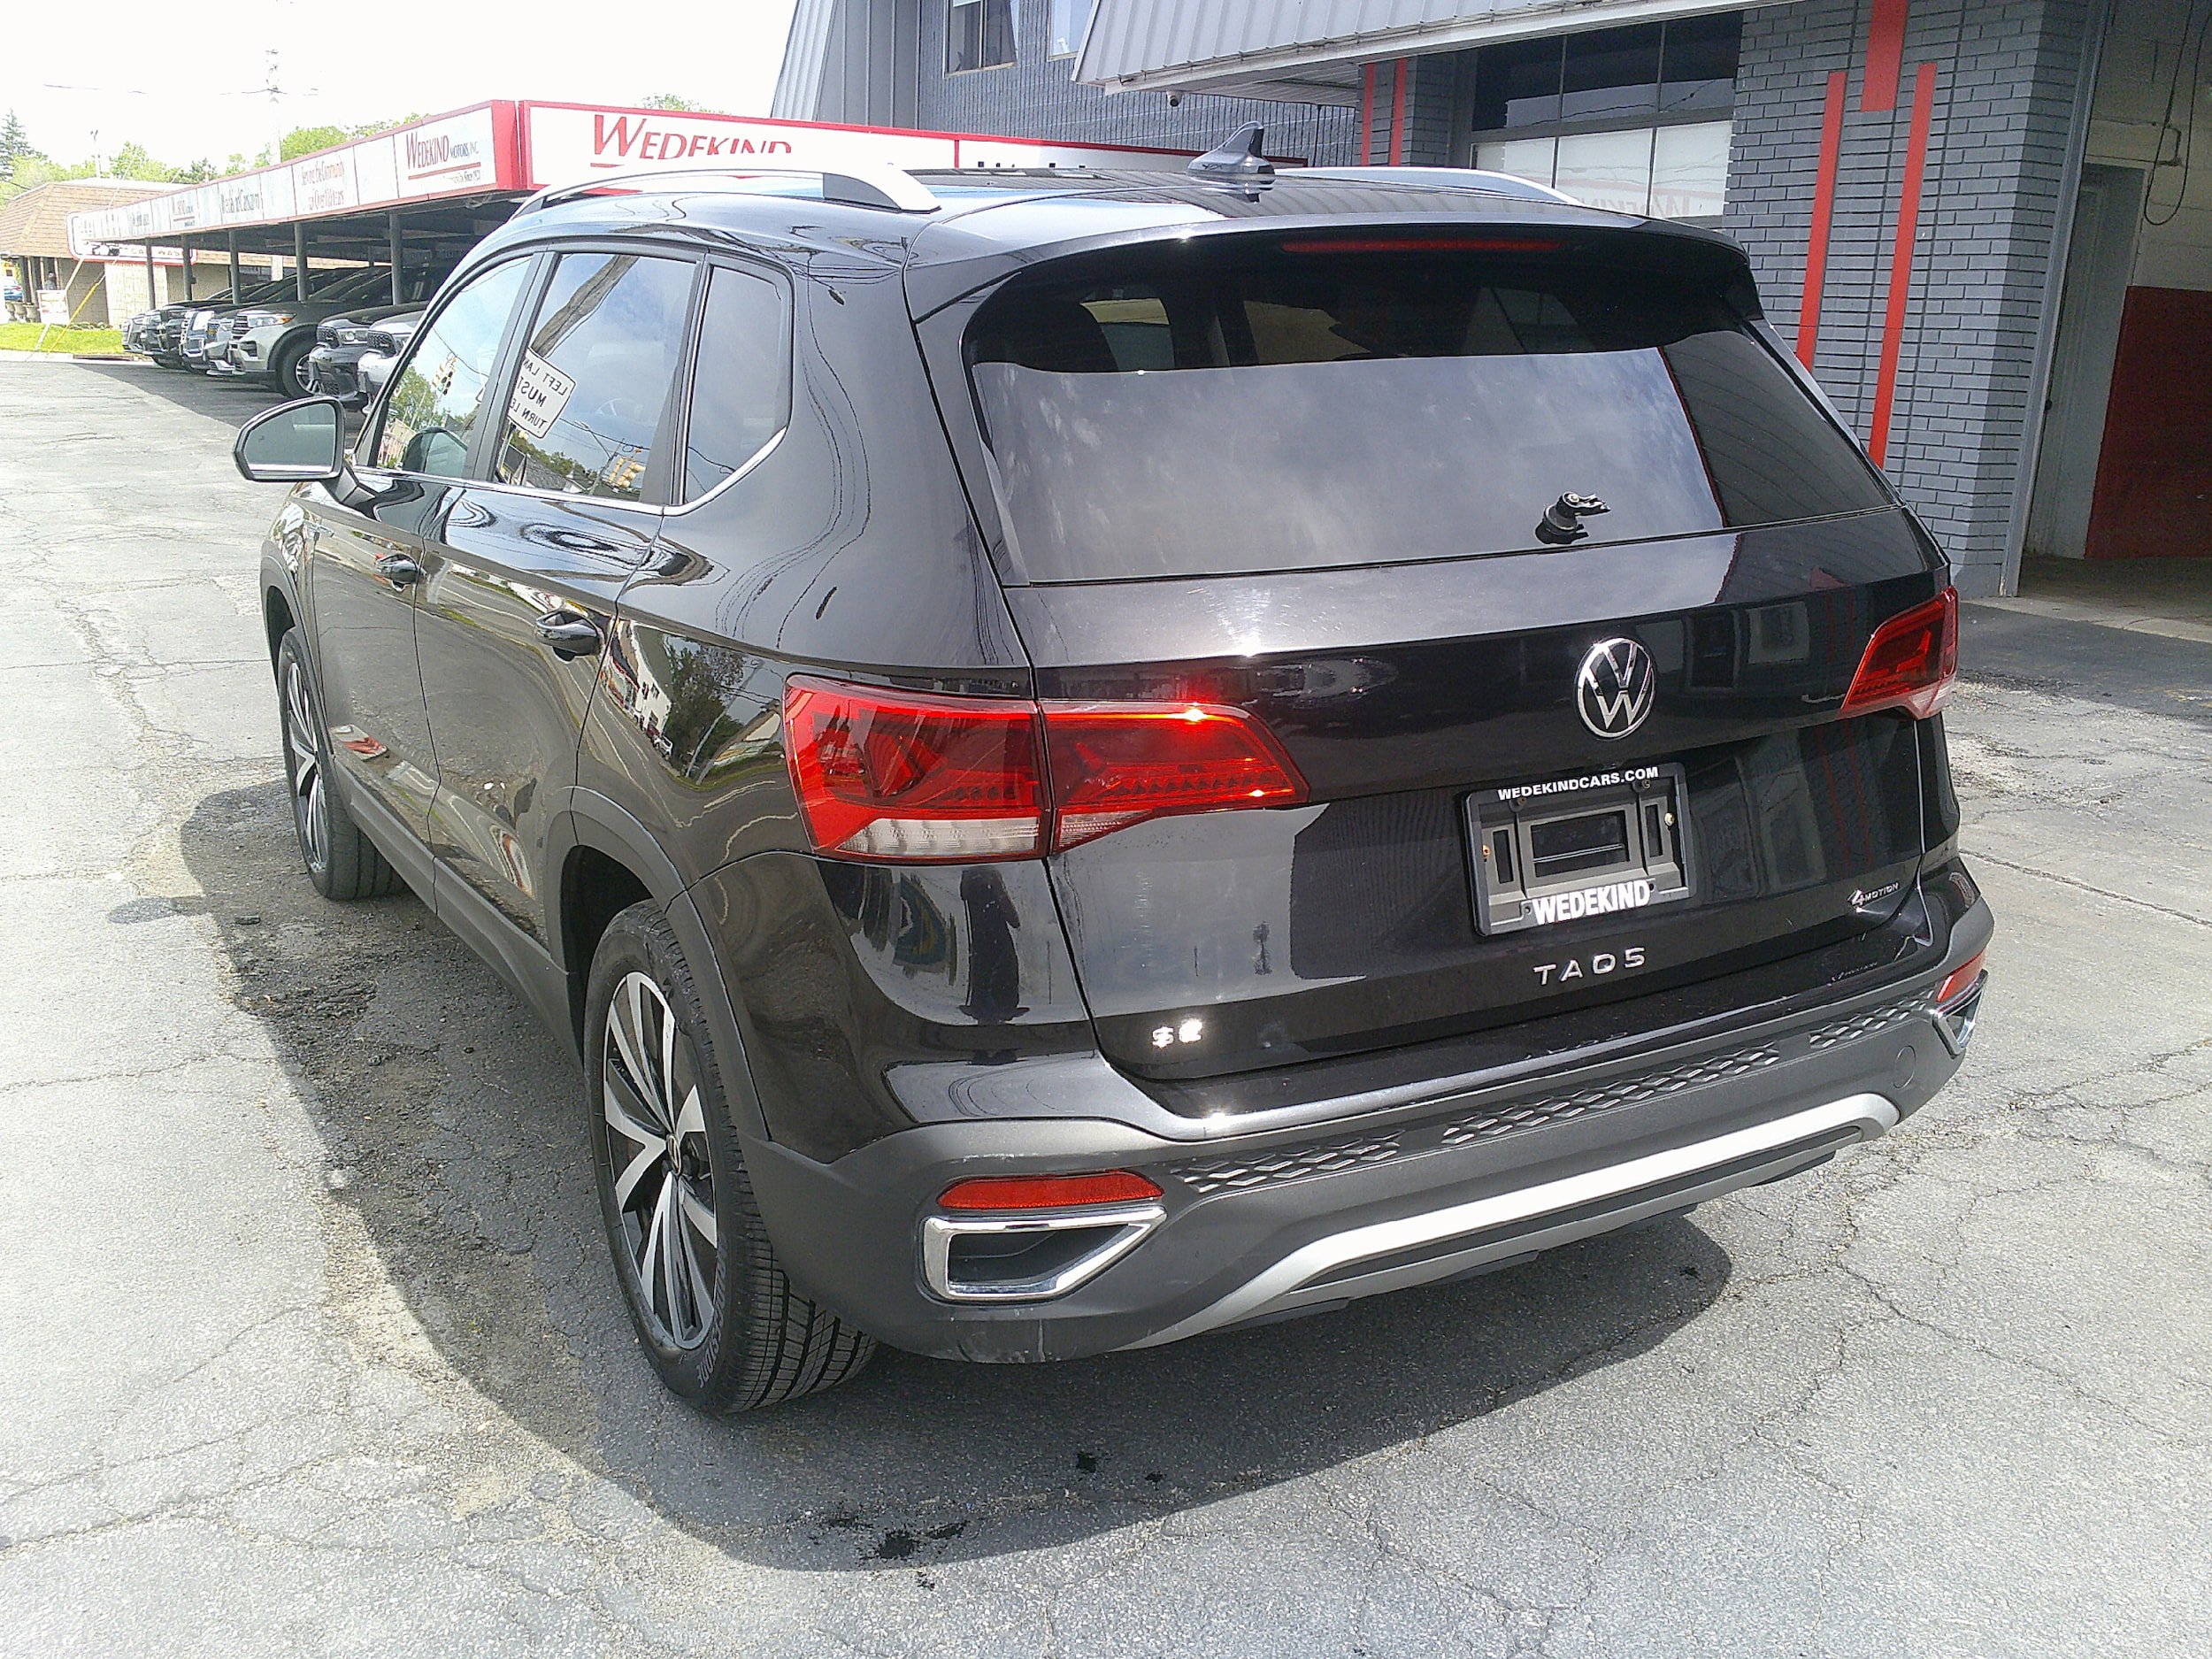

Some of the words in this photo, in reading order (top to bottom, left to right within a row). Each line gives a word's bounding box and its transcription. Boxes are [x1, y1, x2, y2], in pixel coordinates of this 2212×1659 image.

[406, 131, 449, 169] WEDEKIND
[1497, 766, 1659, 801] WEDEKINDCARS.COM
[1532, 879, 1650, 926] WEDEKIND
[1847, 882, 1899, 906] 4MOTION
[1532, 947, 1645, 985] TAOS
